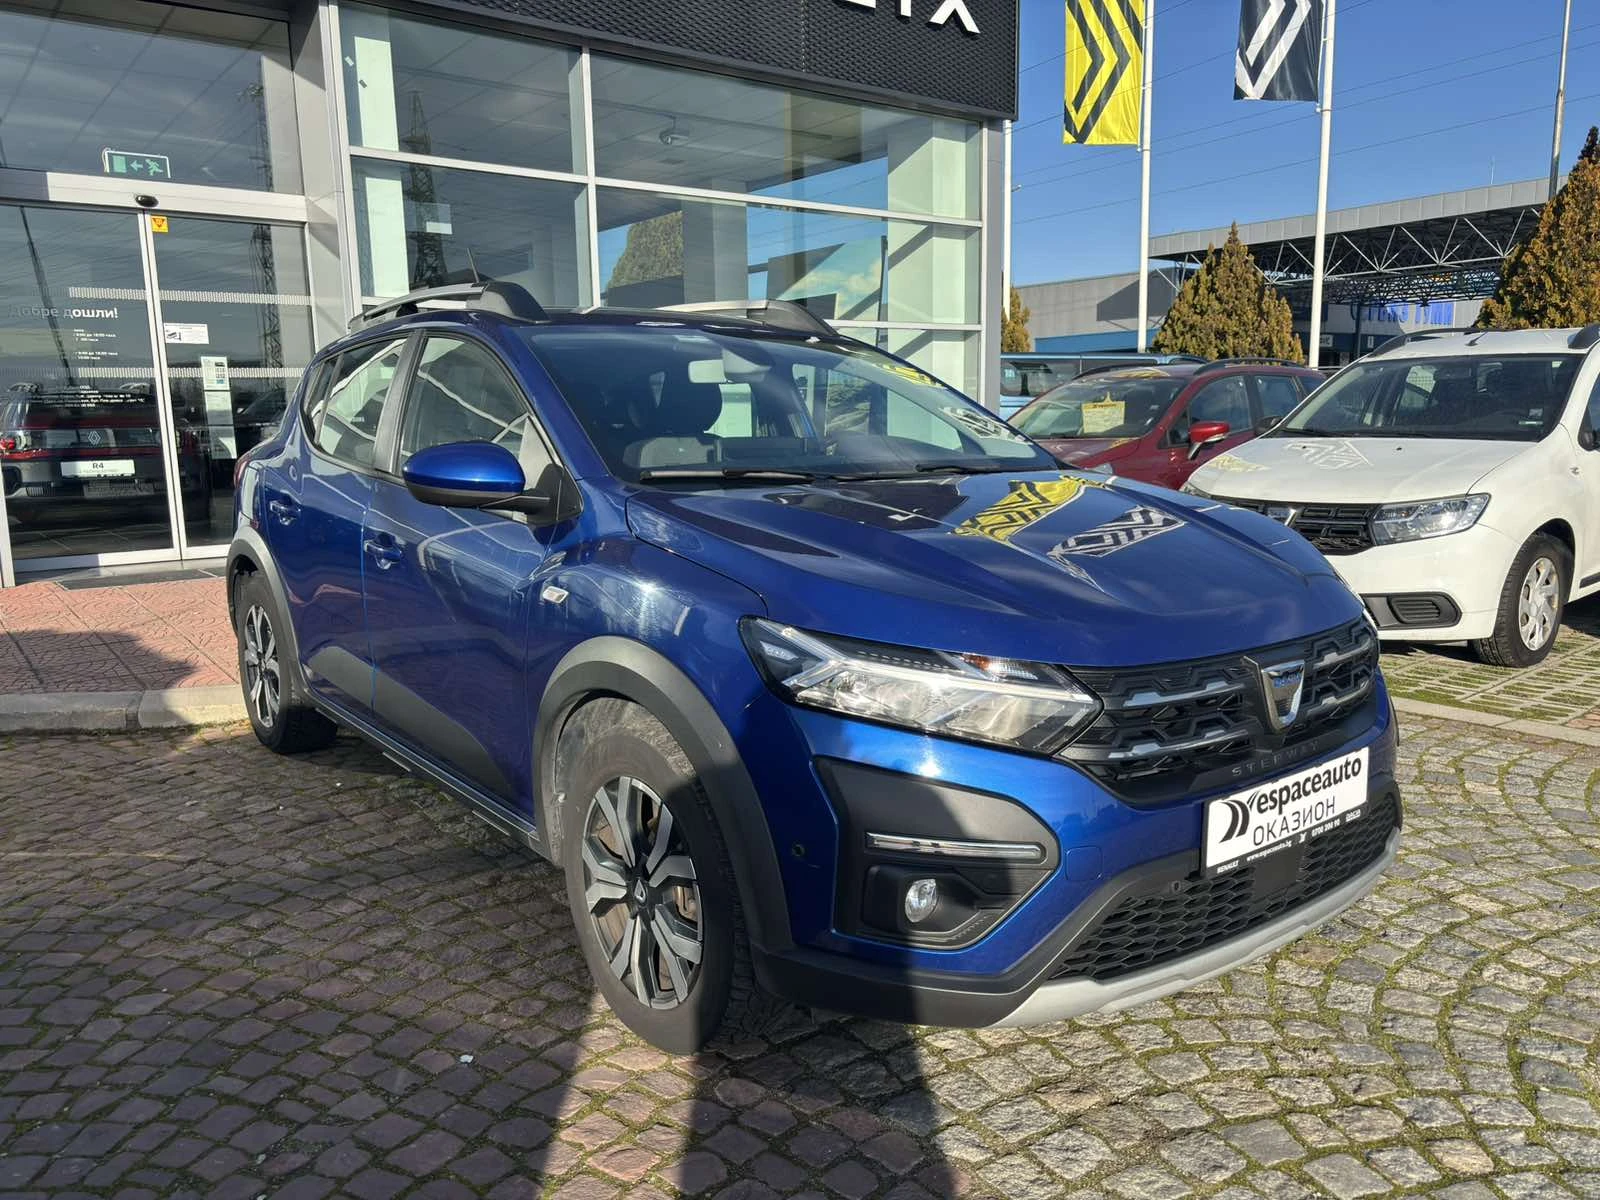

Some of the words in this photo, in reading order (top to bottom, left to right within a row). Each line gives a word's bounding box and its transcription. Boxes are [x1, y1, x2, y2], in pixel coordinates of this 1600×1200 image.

[64, 307, 118, 319] дошли!
[1231, 741, 1319, 777] STEPWAY
[1256, 757, 1362, 815] espaceauto
[1253, 796, 1336, 847] ОКАЗИОН
